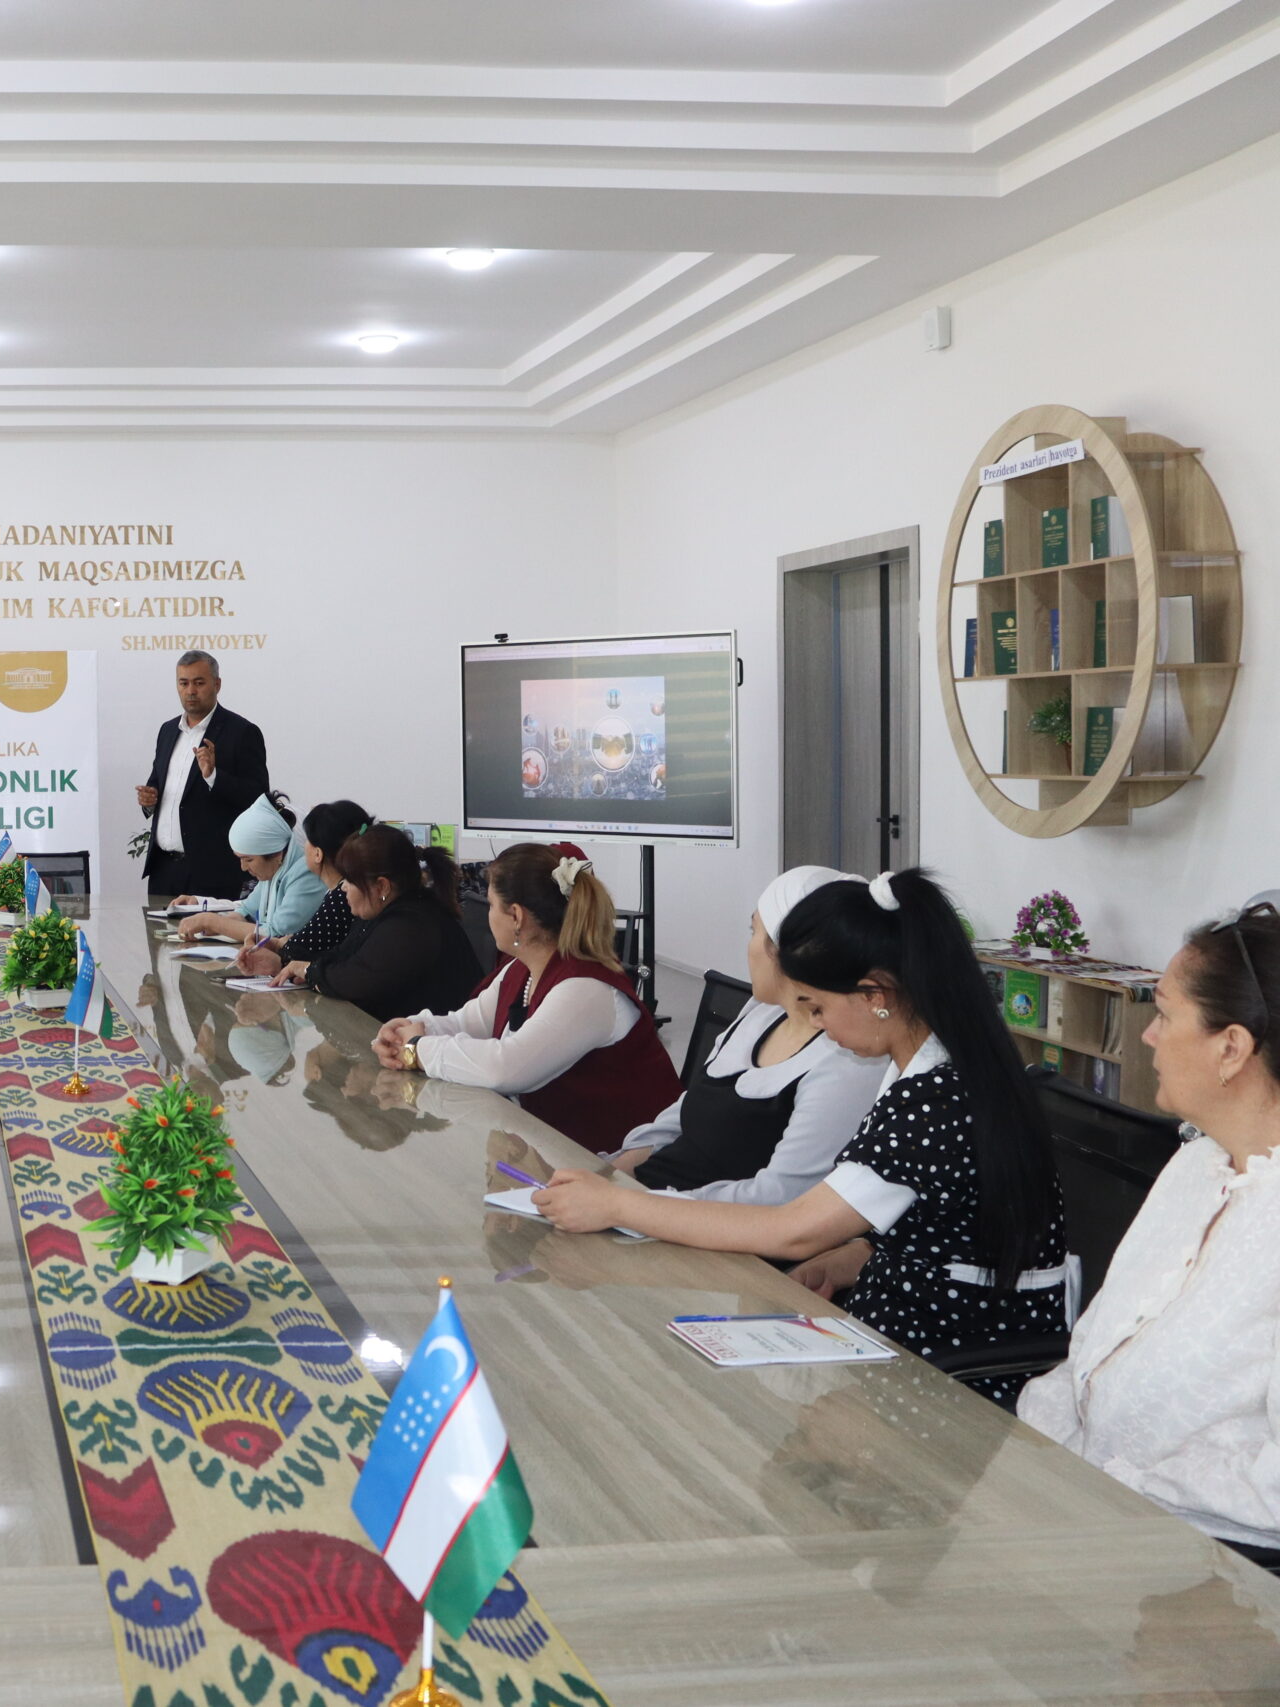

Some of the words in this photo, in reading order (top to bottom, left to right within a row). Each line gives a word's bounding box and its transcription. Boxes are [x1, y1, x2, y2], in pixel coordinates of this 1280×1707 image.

[983, 463, 1018, 481] Prezident
[1020, 452, 1047, 470] asarlari
[1049, 446, 1078, 463] hayotga
[38, 559, 246, 586] MAQSADIMIZGA
[47, 595, 235, 619] KAFOLATIDIR.
[121, 633, 268, 651] SH.MIRZIYOYEV
